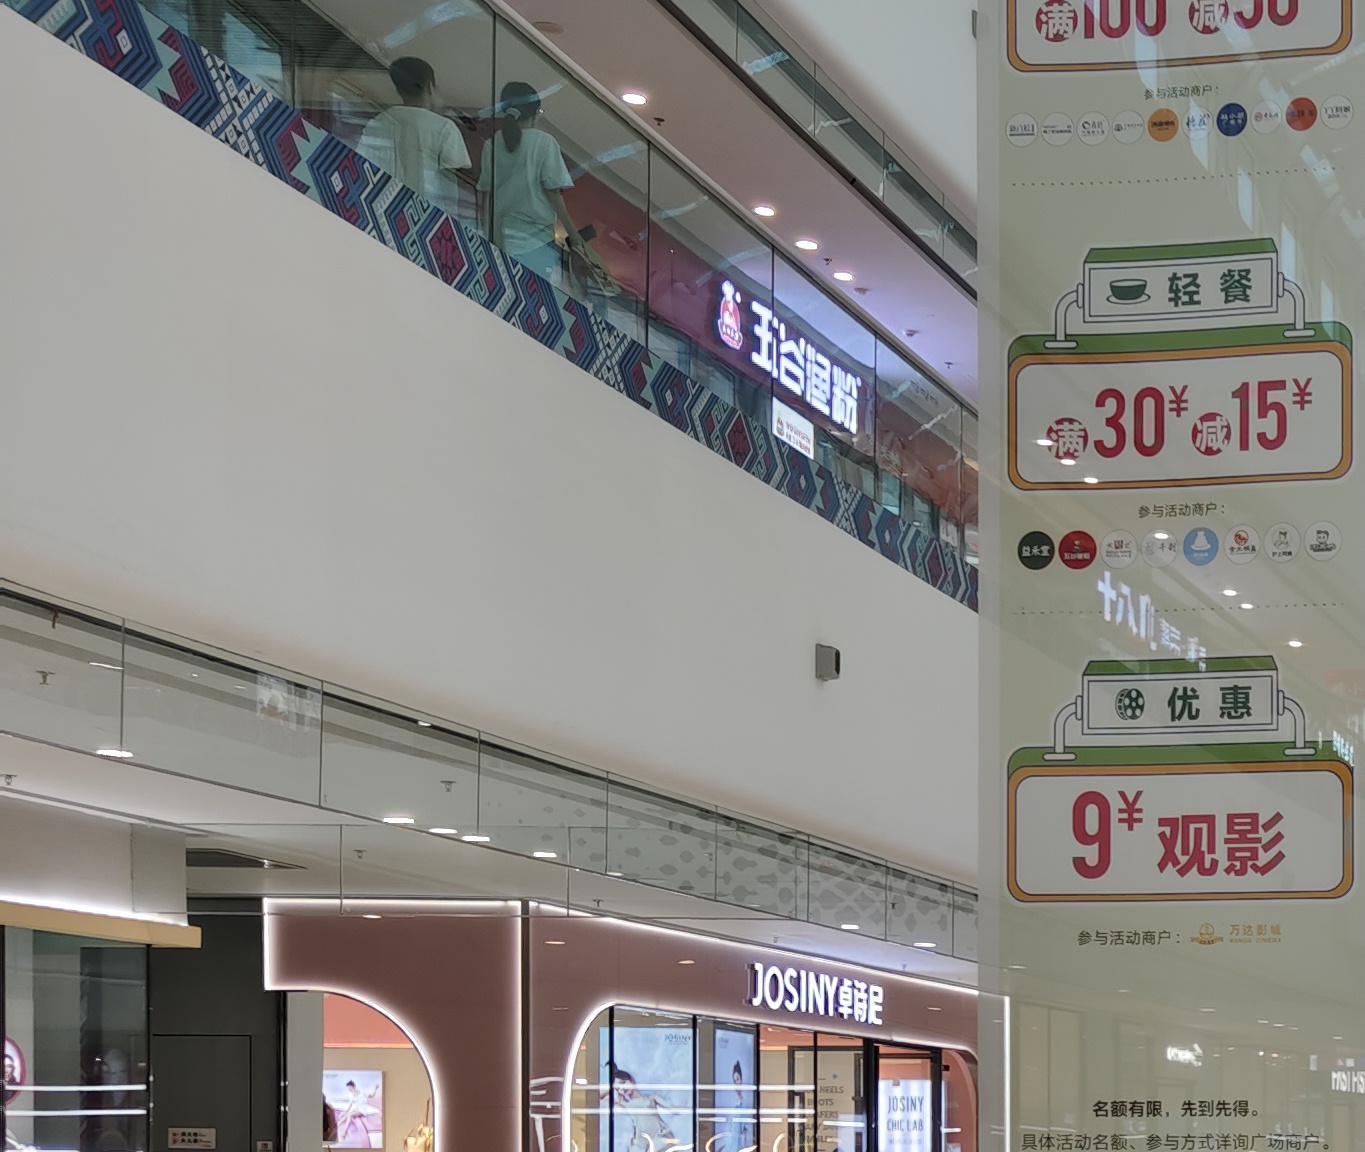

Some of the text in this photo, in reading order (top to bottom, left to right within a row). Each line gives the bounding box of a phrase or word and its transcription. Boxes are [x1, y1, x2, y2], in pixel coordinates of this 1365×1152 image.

[1168, 268, 1253, 308] 轻餐
[750, 301, 863, 435] 五谷渔粉
[1168, 685, 1253, 722] 优惠
[752, 962, 838, 1017] JOSINY
[807, 1098, 834, 1107] BOTS
[887, 1095, 925, 1114] JOSINY
[1092, 1100, 1263, 1118] 名额有限，先到先得。
[1021, 1133, 1331, 1152] 具体活动名额、参与方式详询广场商户。
